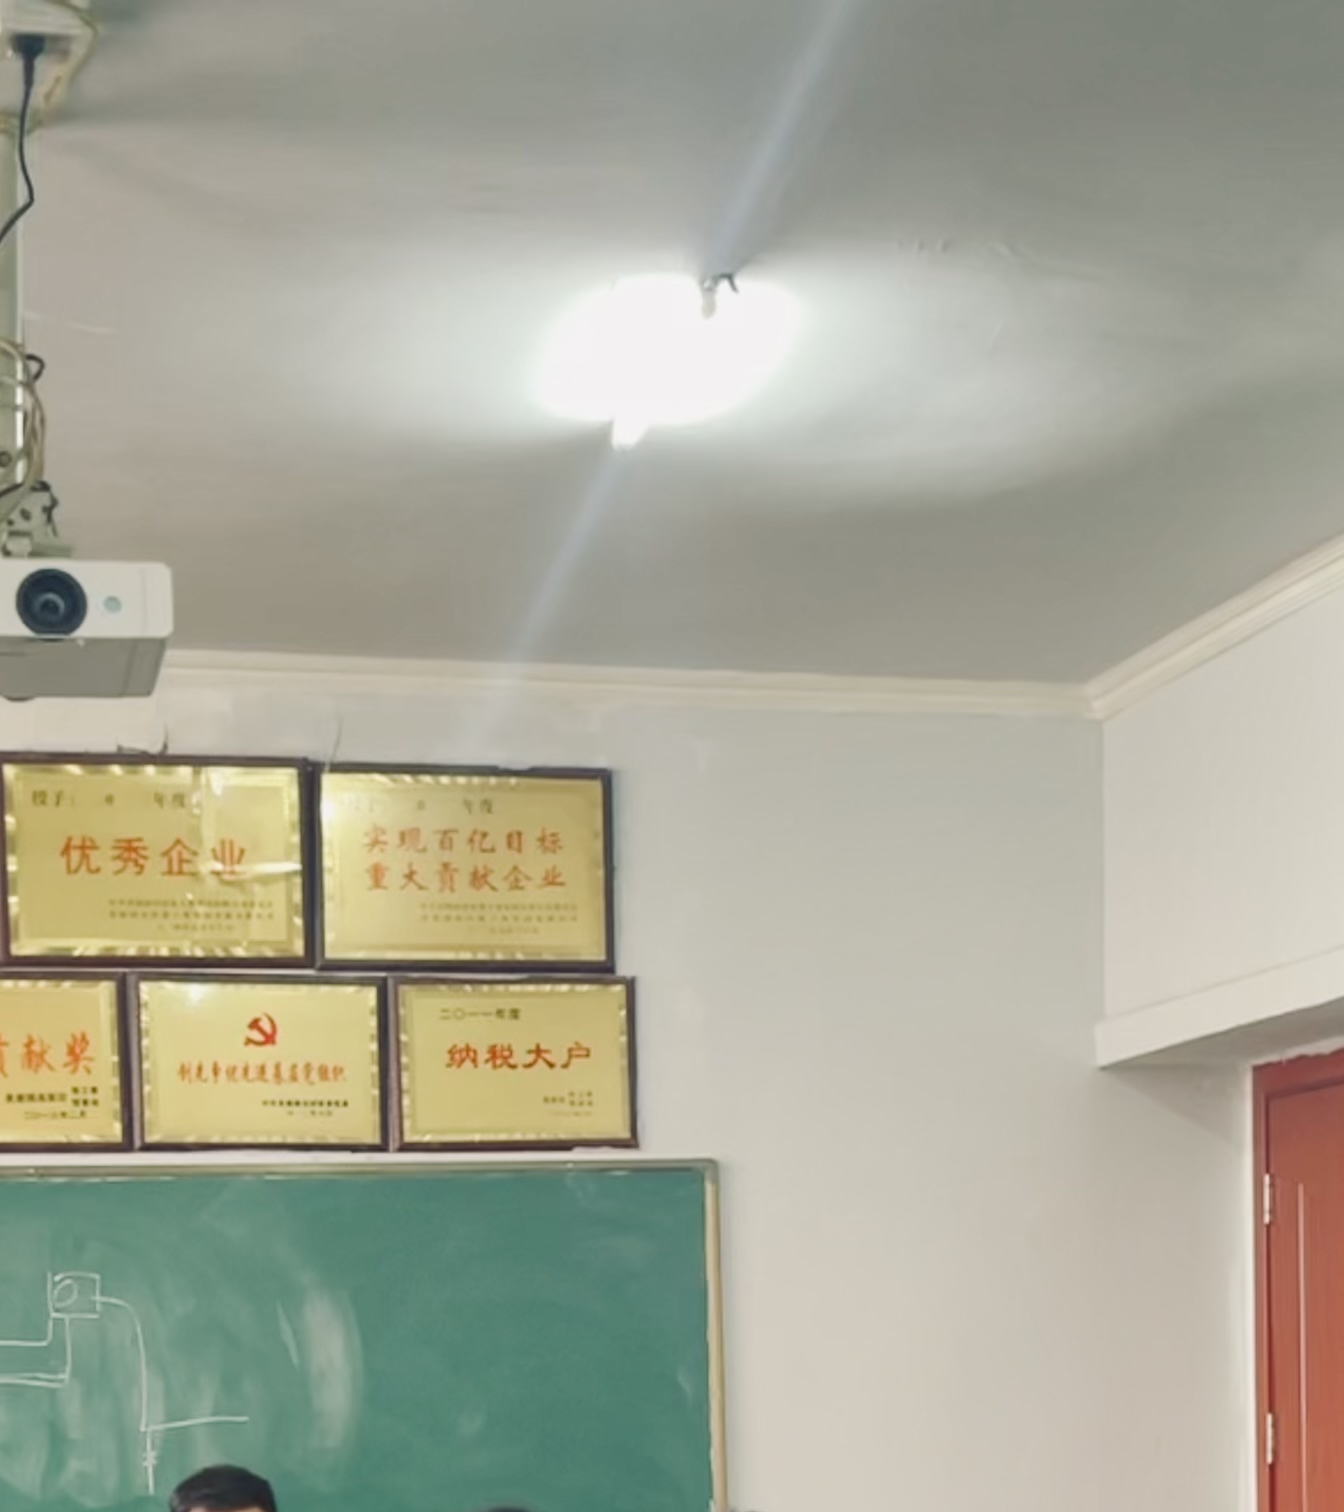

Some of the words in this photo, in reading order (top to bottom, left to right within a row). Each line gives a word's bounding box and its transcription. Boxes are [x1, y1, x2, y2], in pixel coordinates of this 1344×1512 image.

[364, 823, 564, 854] 实现百亿目标
[60, 835, 246, 877] 优秀企业
[365, 861, 567, 893] 重大贡献企业
[445, 1041, 592, 1070] 纳税大户
